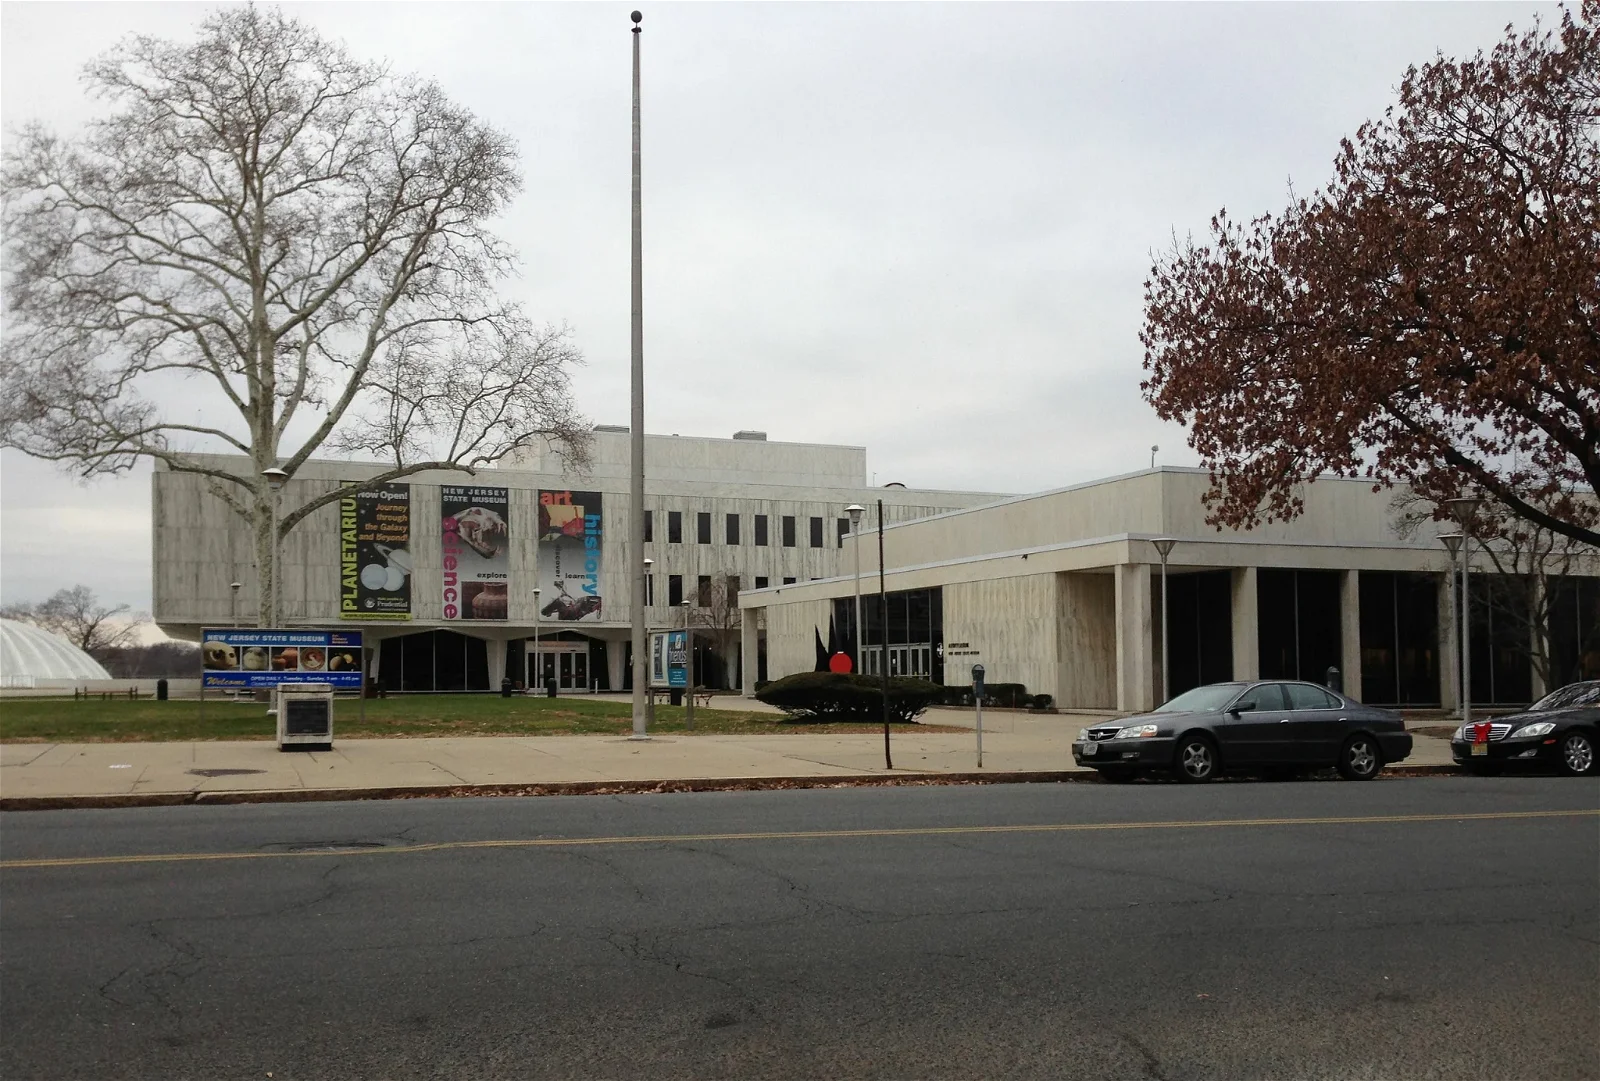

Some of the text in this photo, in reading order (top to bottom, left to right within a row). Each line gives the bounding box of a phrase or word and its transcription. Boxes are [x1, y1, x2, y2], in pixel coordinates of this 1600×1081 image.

[379, 490, 408, 501] Open!
[443, 487, 465, 495] NEW
[443, 495, 507, 504] STATE MUSEUM
[540, 491, 572, 505] art
[376, 504, 408, 513] Journey
[376, 514, 408, 523] through
[380, 523, 408, 533] Galaxy
[359, 533, 374, 541] and
[582, 515, 601, 596] history
[443, 517, 463, 619] science
[206, 677, 245, 685] Welcome
